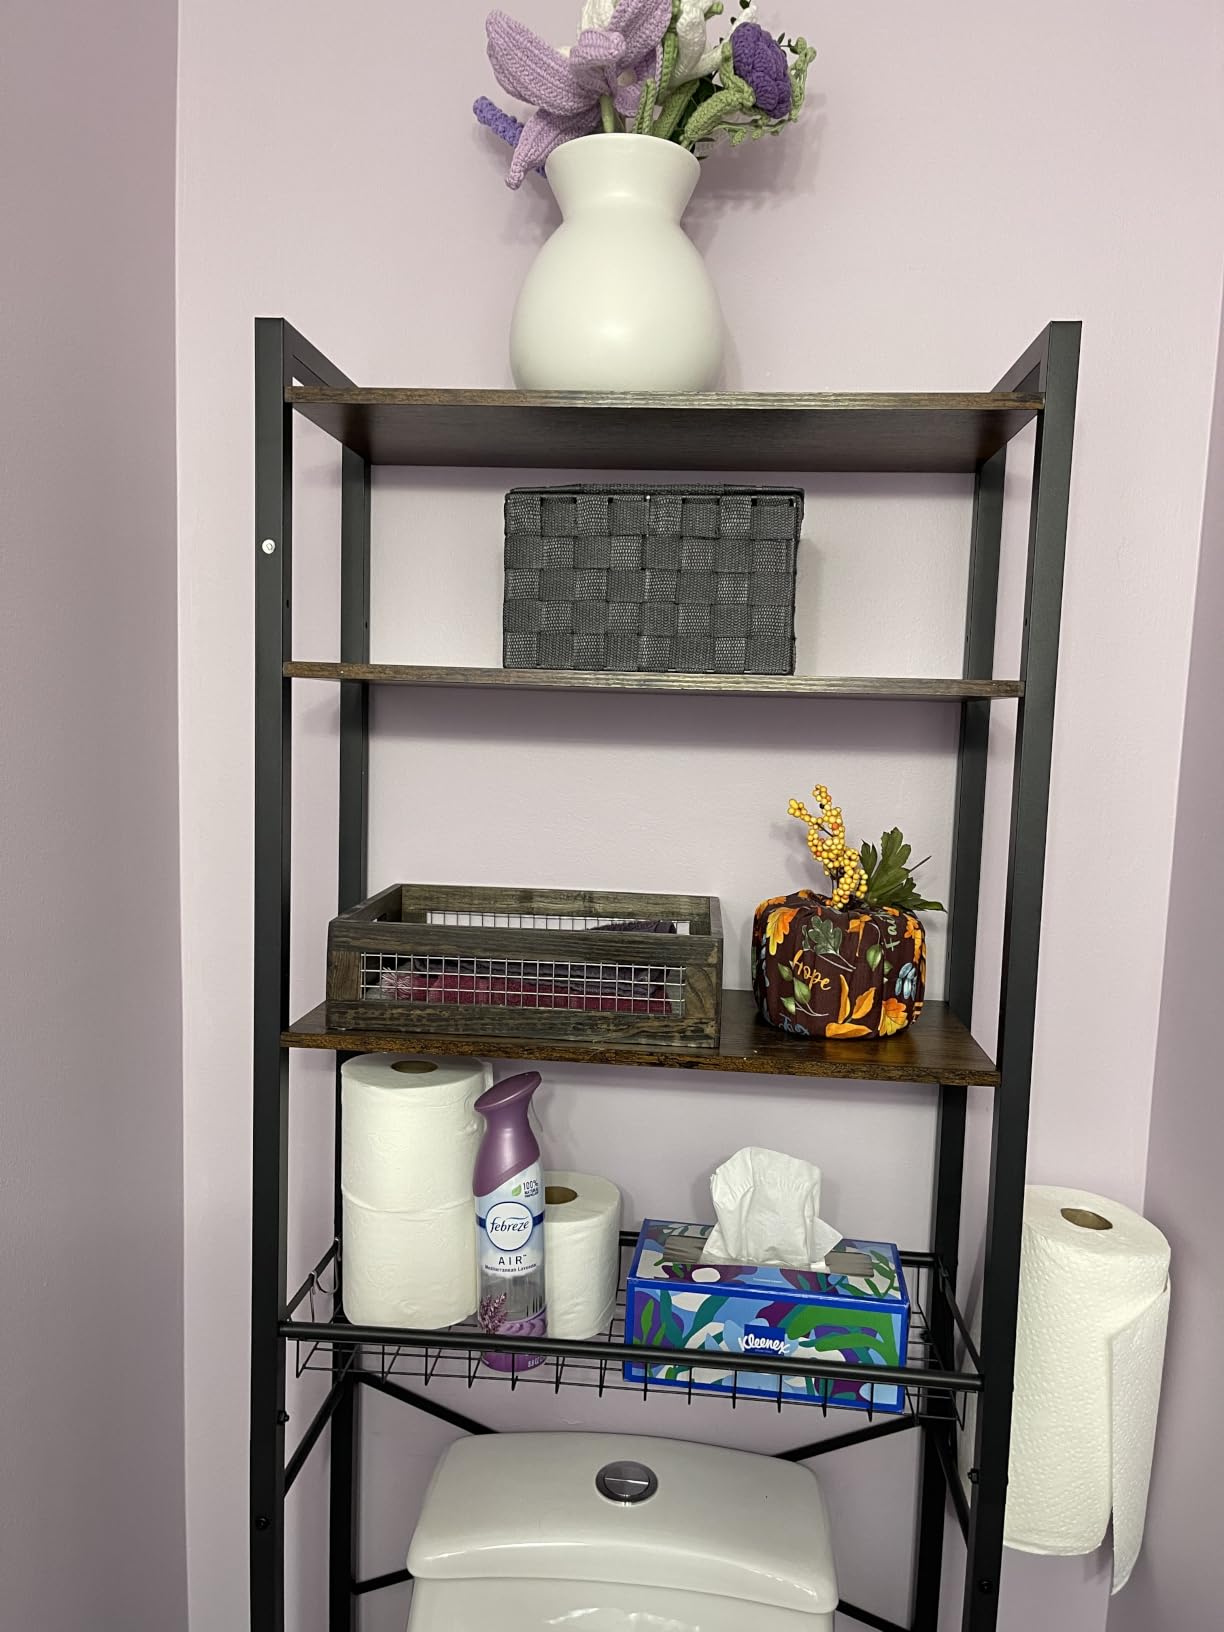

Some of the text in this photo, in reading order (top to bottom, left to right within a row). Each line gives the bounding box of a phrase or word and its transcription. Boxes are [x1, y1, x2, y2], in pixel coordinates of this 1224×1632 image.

[523, 1180, 539, 1191] 100%
[490, 1217, 529, 1233] febreze
[738, 1333, 791, 1355] Kleenex
